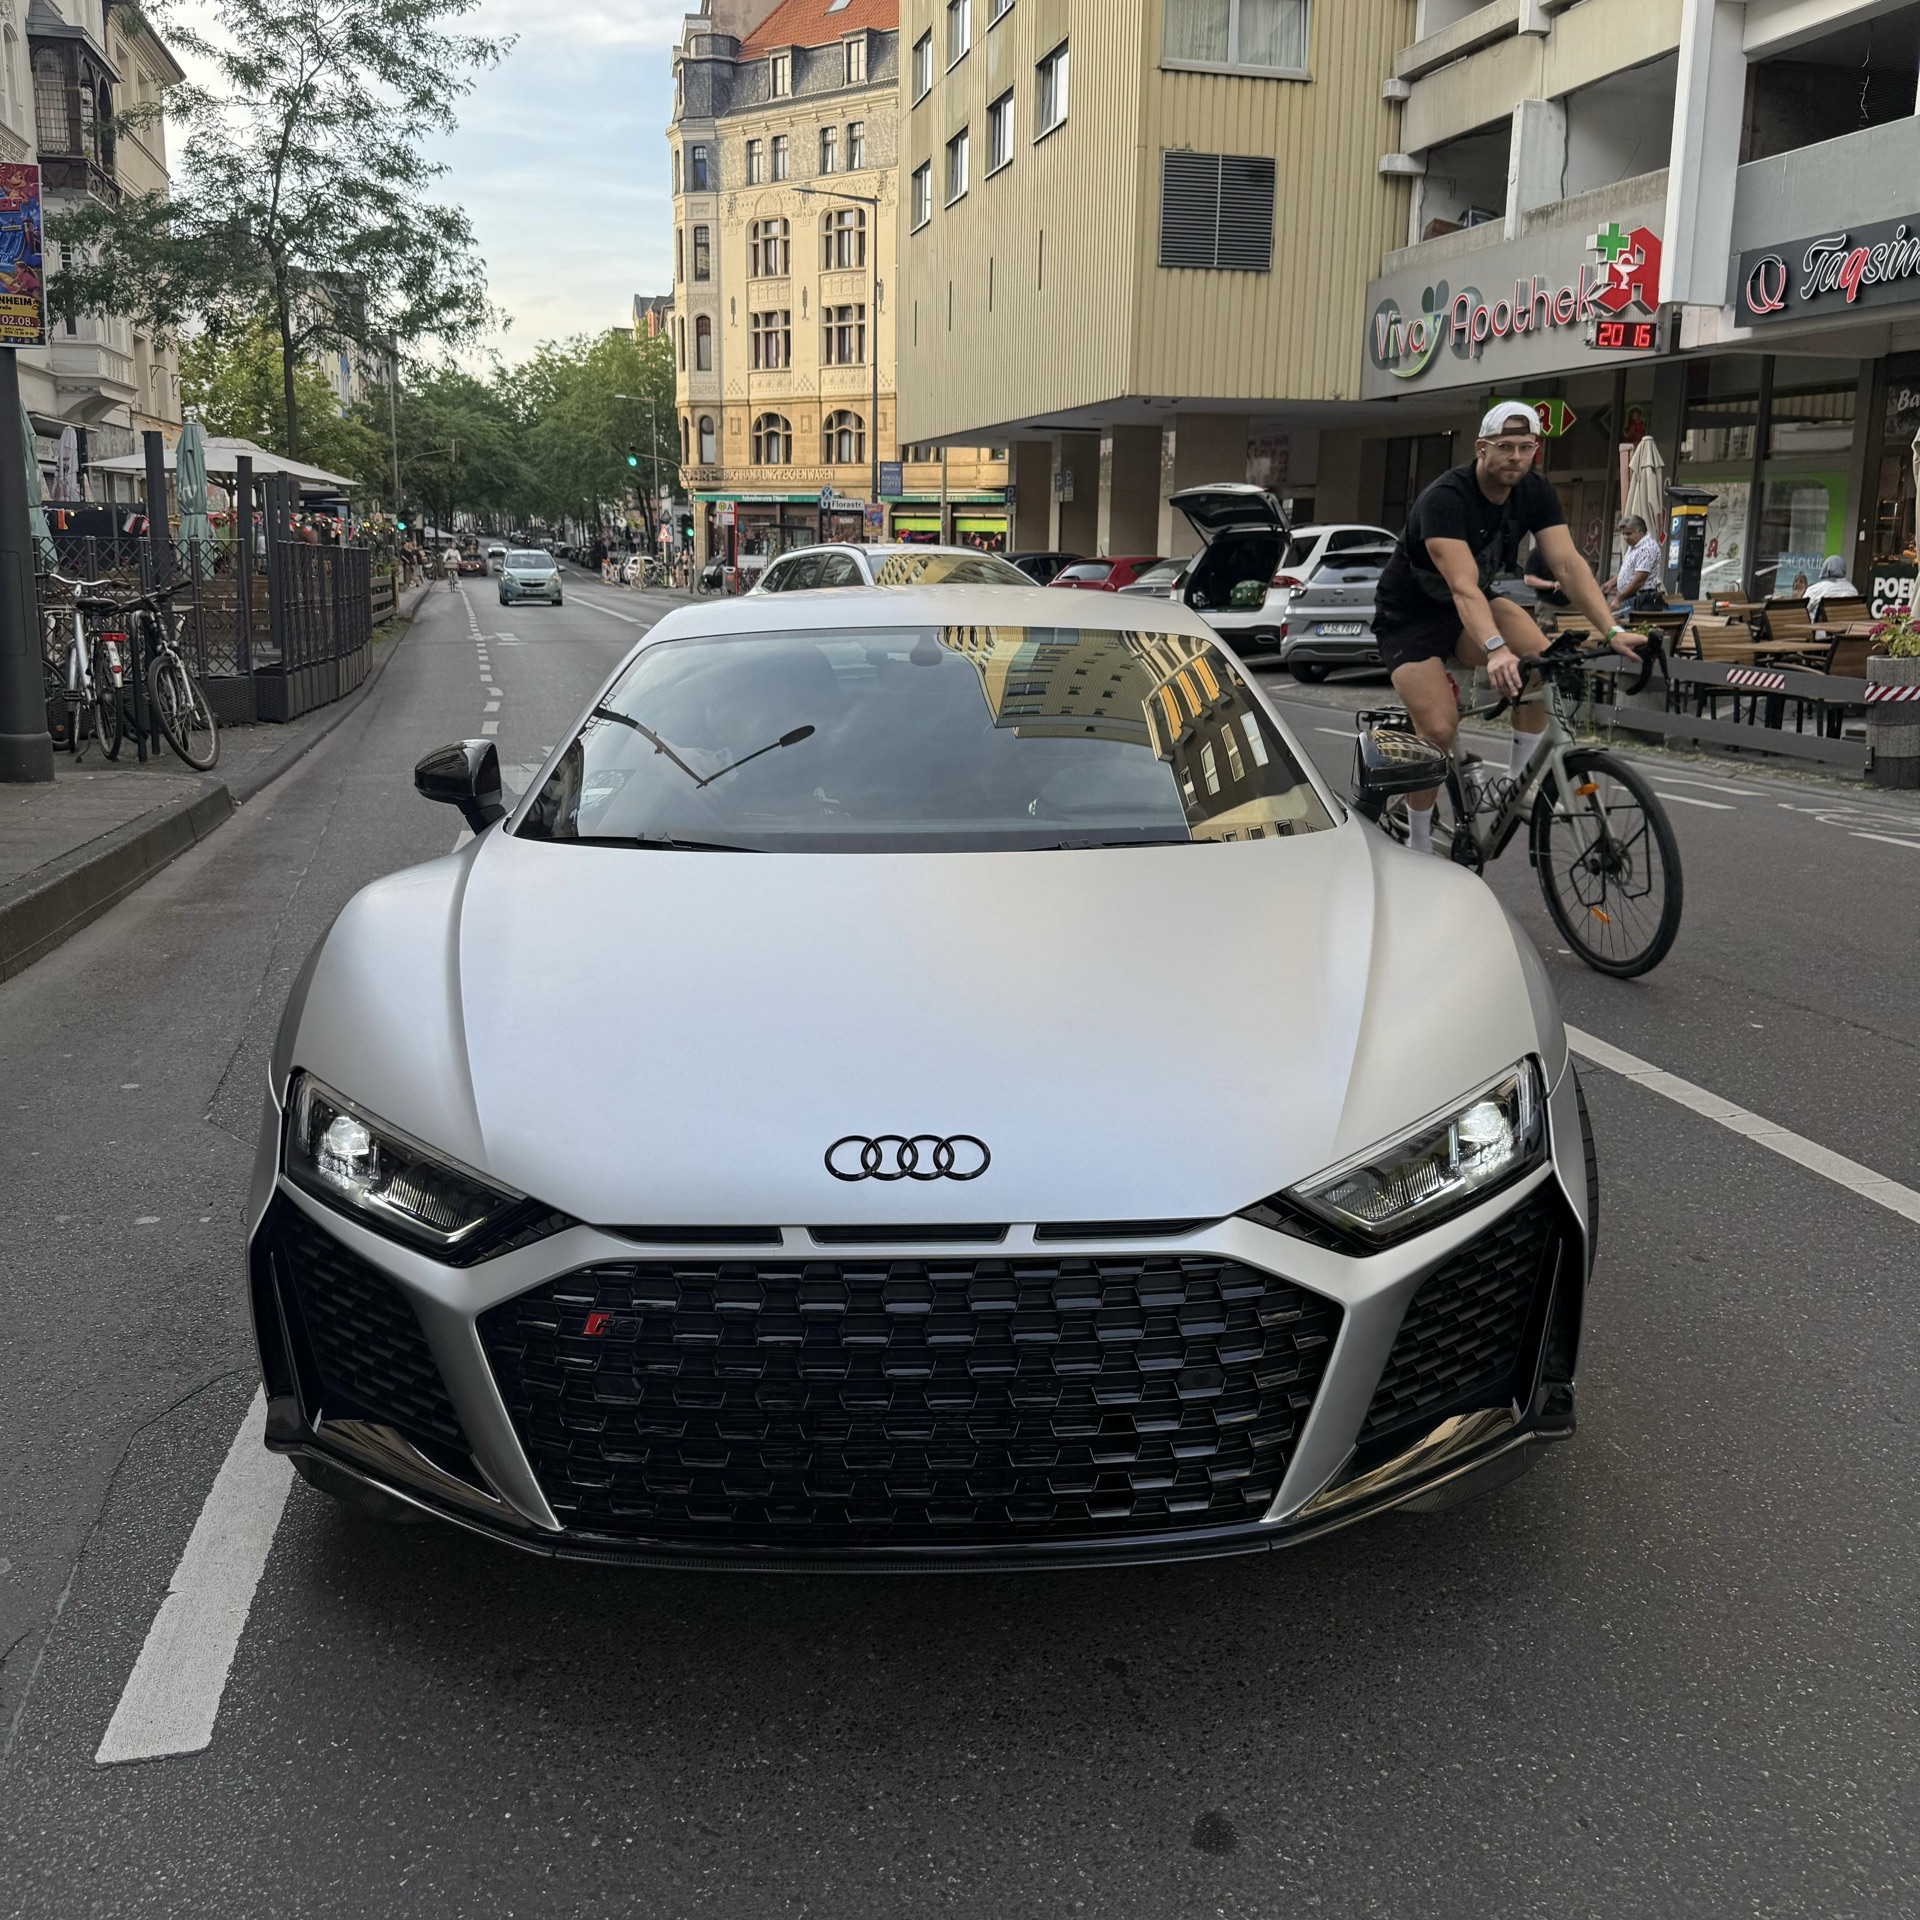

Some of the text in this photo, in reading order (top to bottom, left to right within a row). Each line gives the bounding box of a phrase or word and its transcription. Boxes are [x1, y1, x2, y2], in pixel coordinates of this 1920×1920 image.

[2, 315, 34, 326] 02.08.
[1376, 264, 1613, 360] Viva Apothek
[1598, 323, 1651, 347] 20 16
[832, 500, 863, 509] Florastr.
